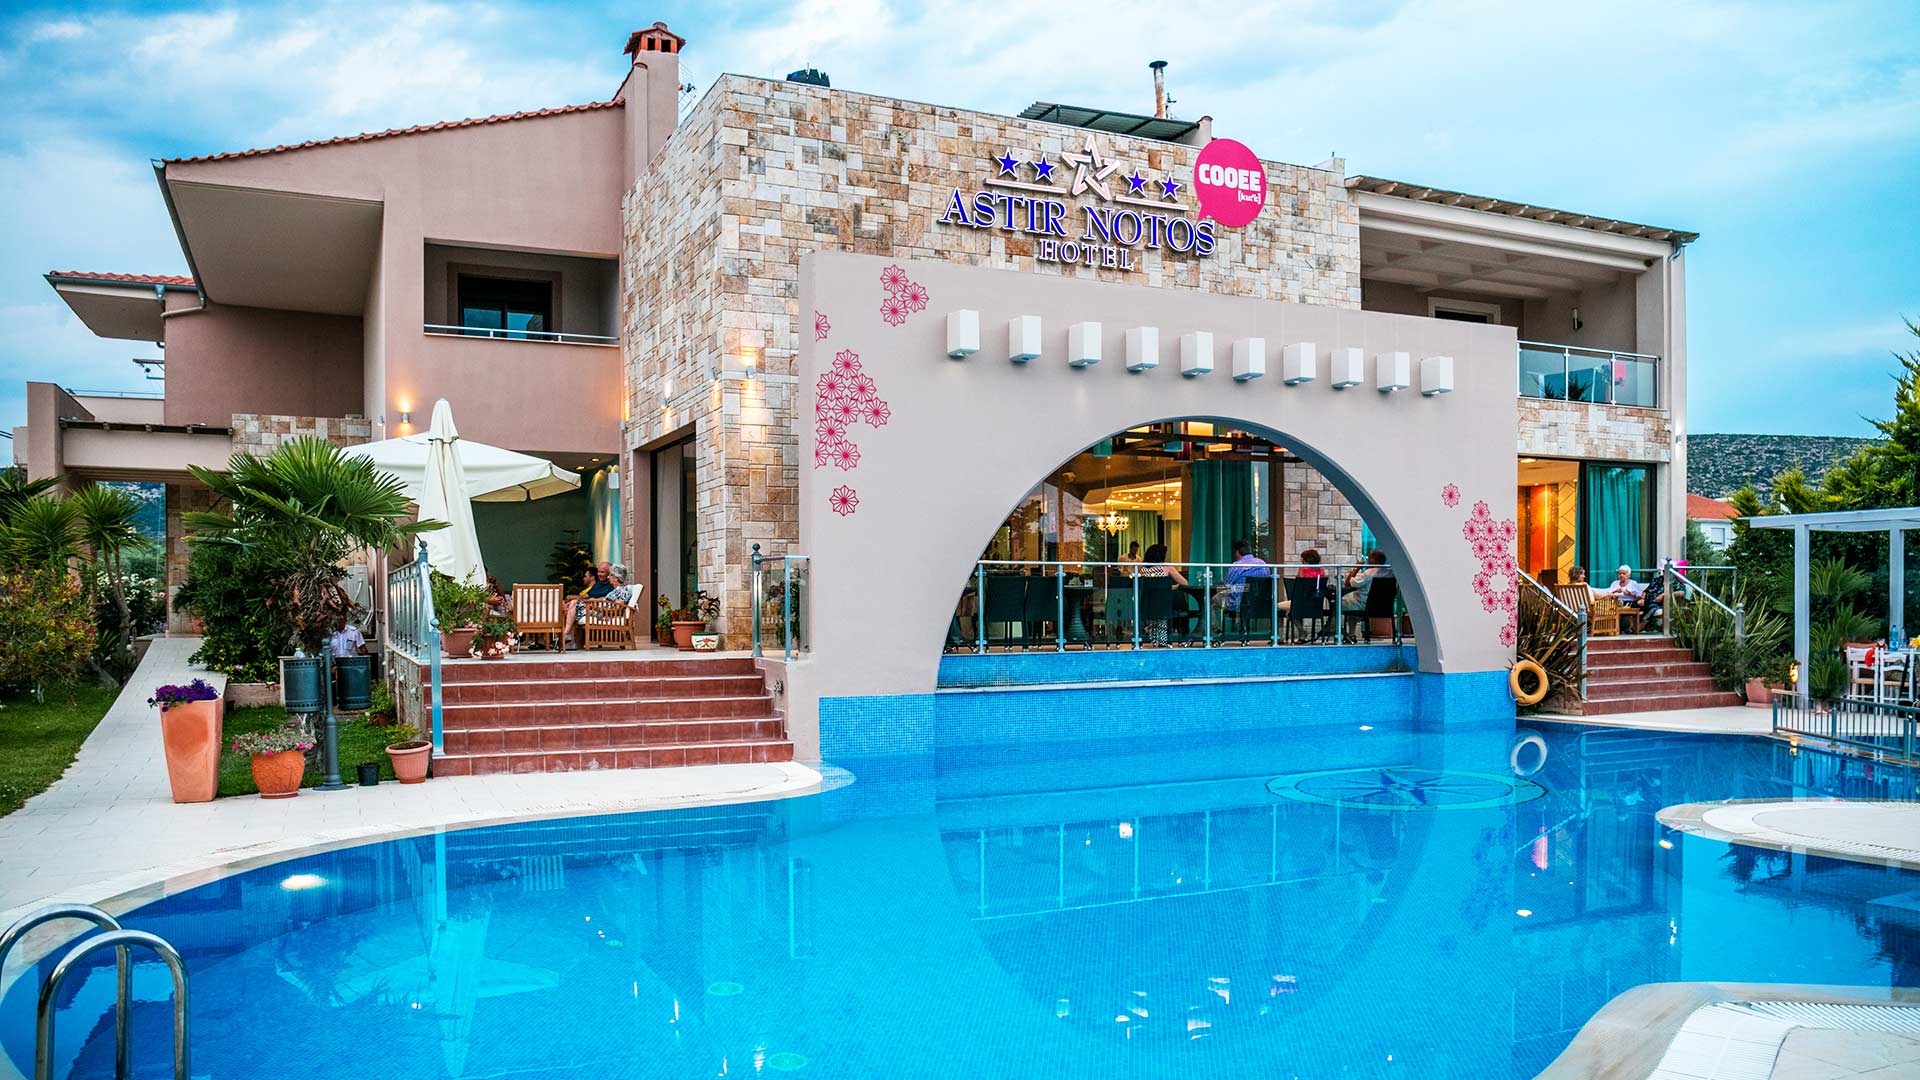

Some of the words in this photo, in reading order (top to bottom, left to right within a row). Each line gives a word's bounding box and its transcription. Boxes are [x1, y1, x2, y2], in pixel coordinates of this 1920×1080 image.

[1198, 163, 1262, 192] COOEE
[940, 188, 1067, 237] ASTIR
[1083, 205, 1216, 256] NOTOS
[1040, 238, 1134, 271] HOTEL
